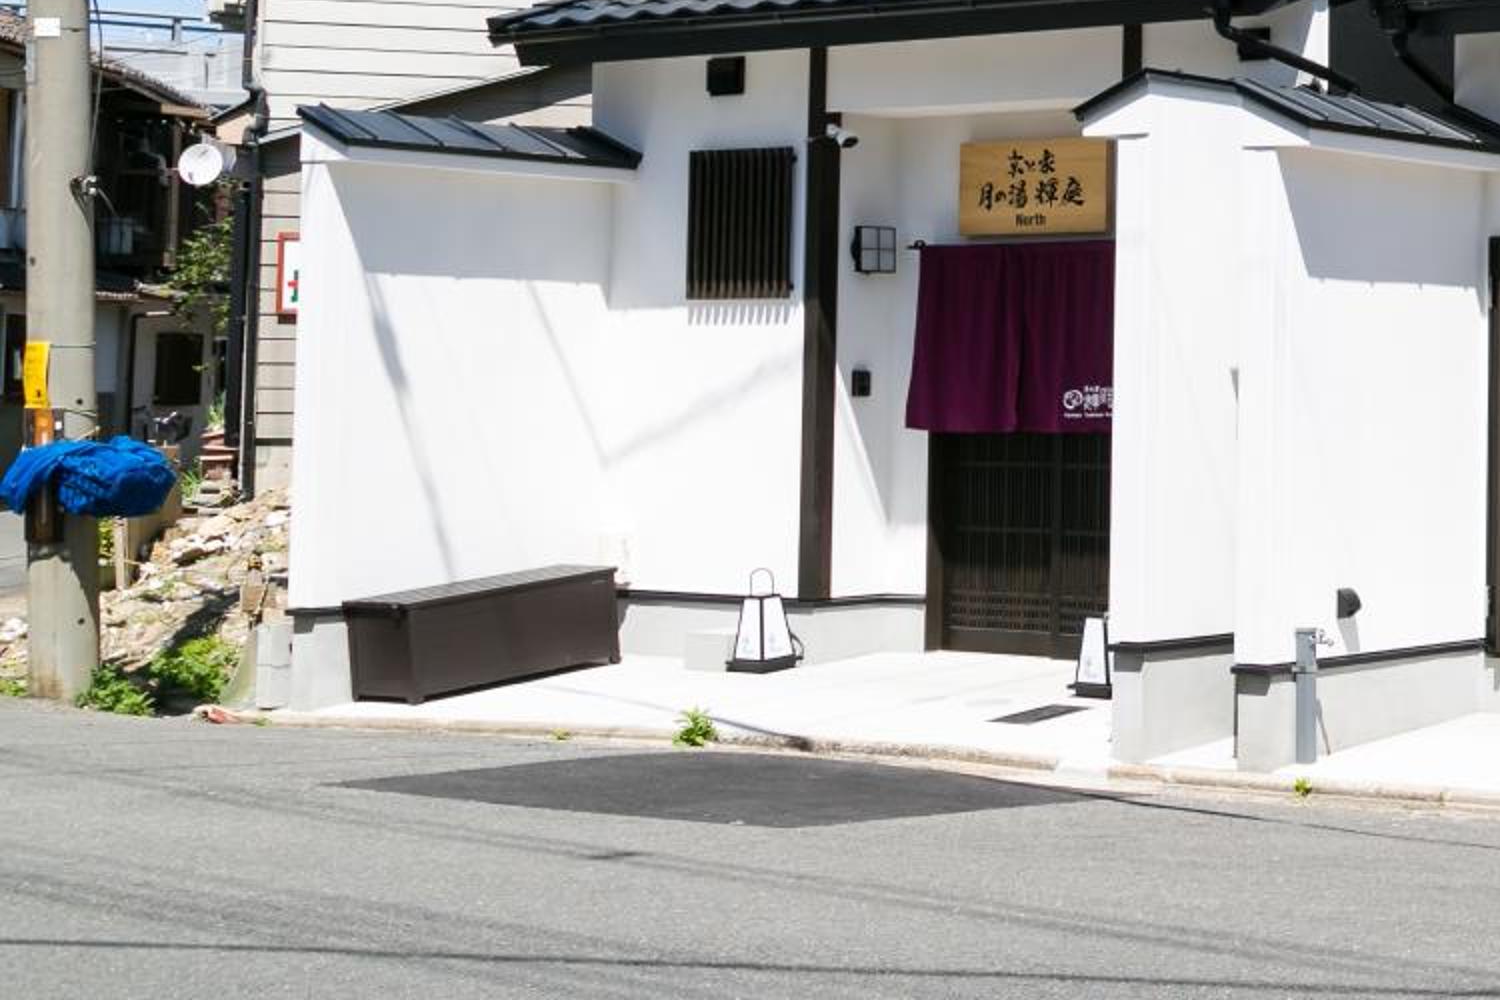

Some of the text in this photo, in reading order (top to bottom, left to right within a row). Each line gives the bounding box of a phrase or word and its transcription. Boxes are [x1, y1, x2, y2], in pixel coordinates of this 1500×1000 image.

[978, 178, 1028, 211] 月の湯
[1015, 213, 1047, 227] North
